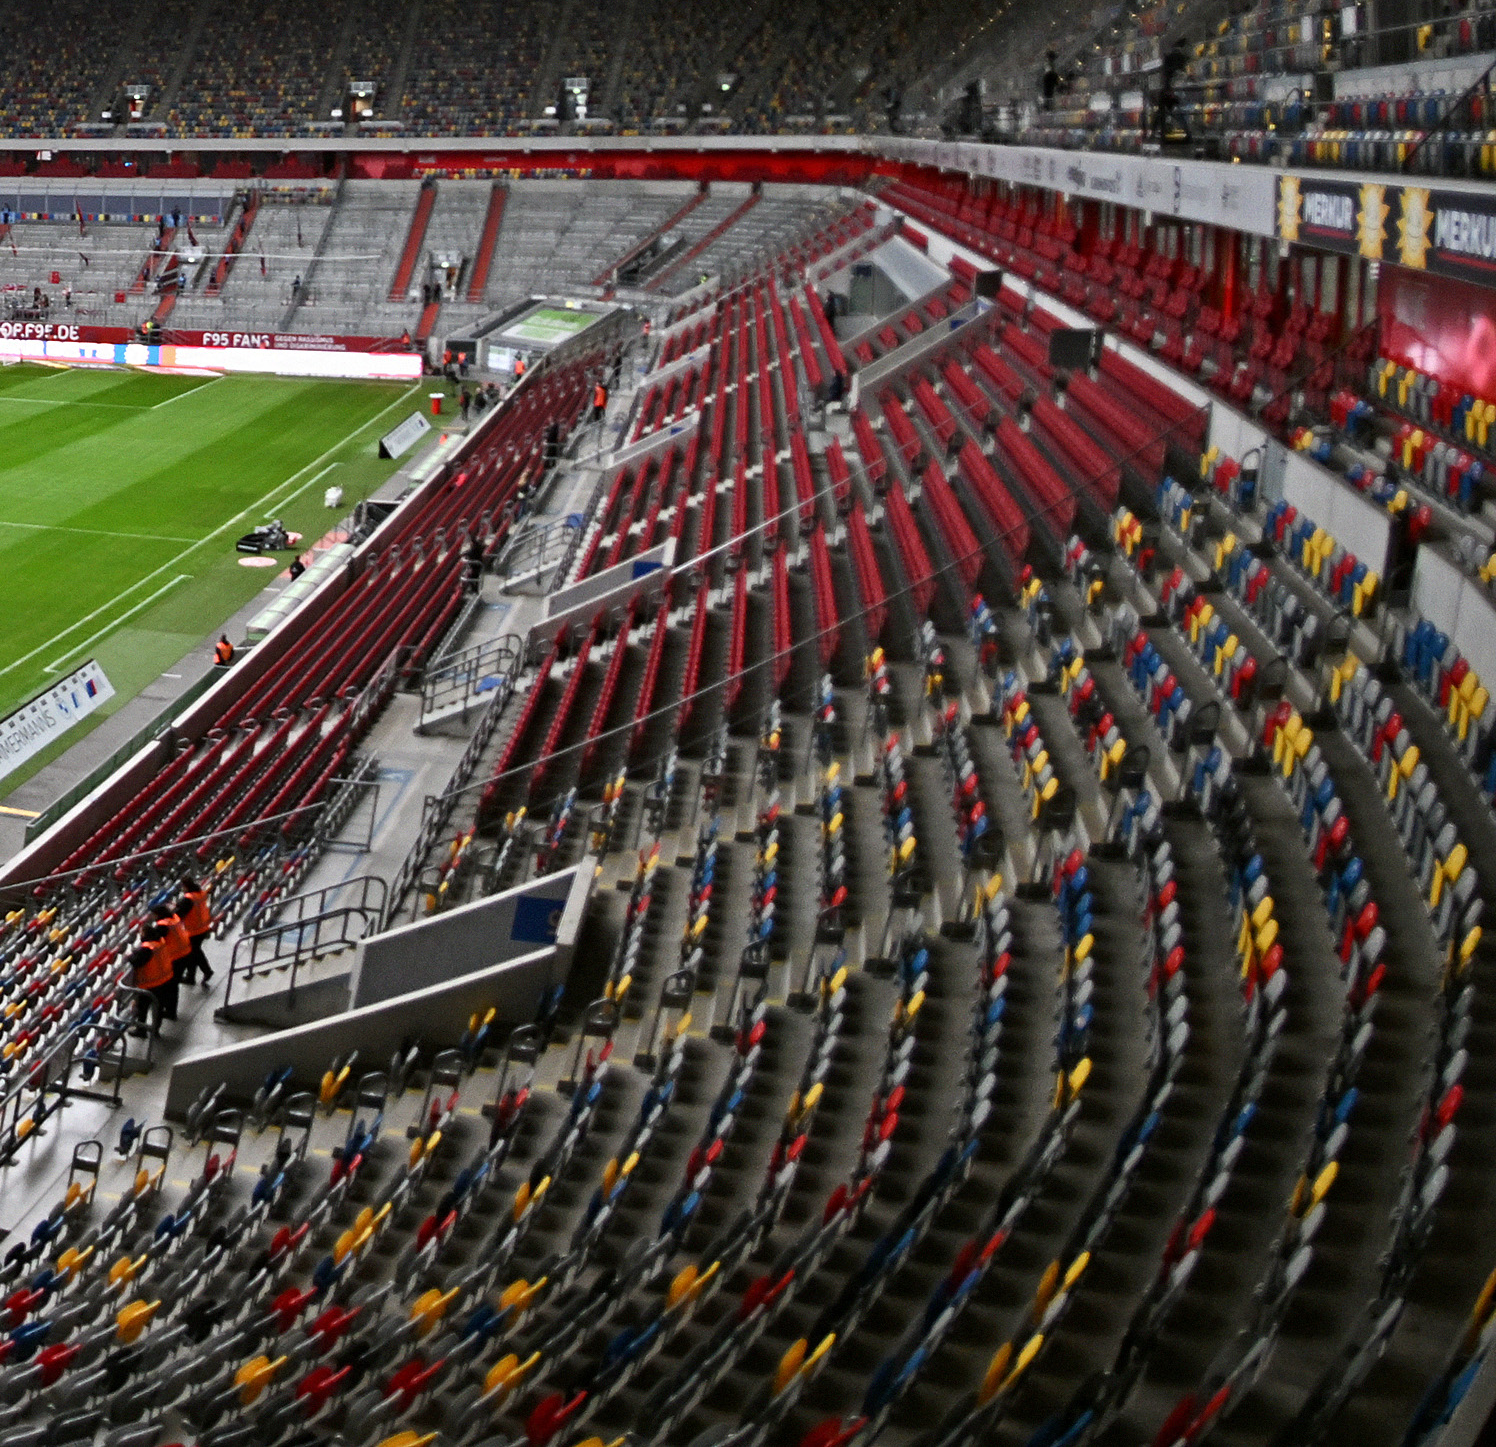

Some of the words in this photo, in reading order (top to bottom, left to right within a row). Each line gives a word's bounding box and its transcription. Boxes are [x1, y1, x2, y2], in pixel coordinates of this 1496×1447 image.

[1303, 192, 1353, 231] MERKUR
[202, 333, 228, 346] F95
[232, 334, 270, 347] FANS
